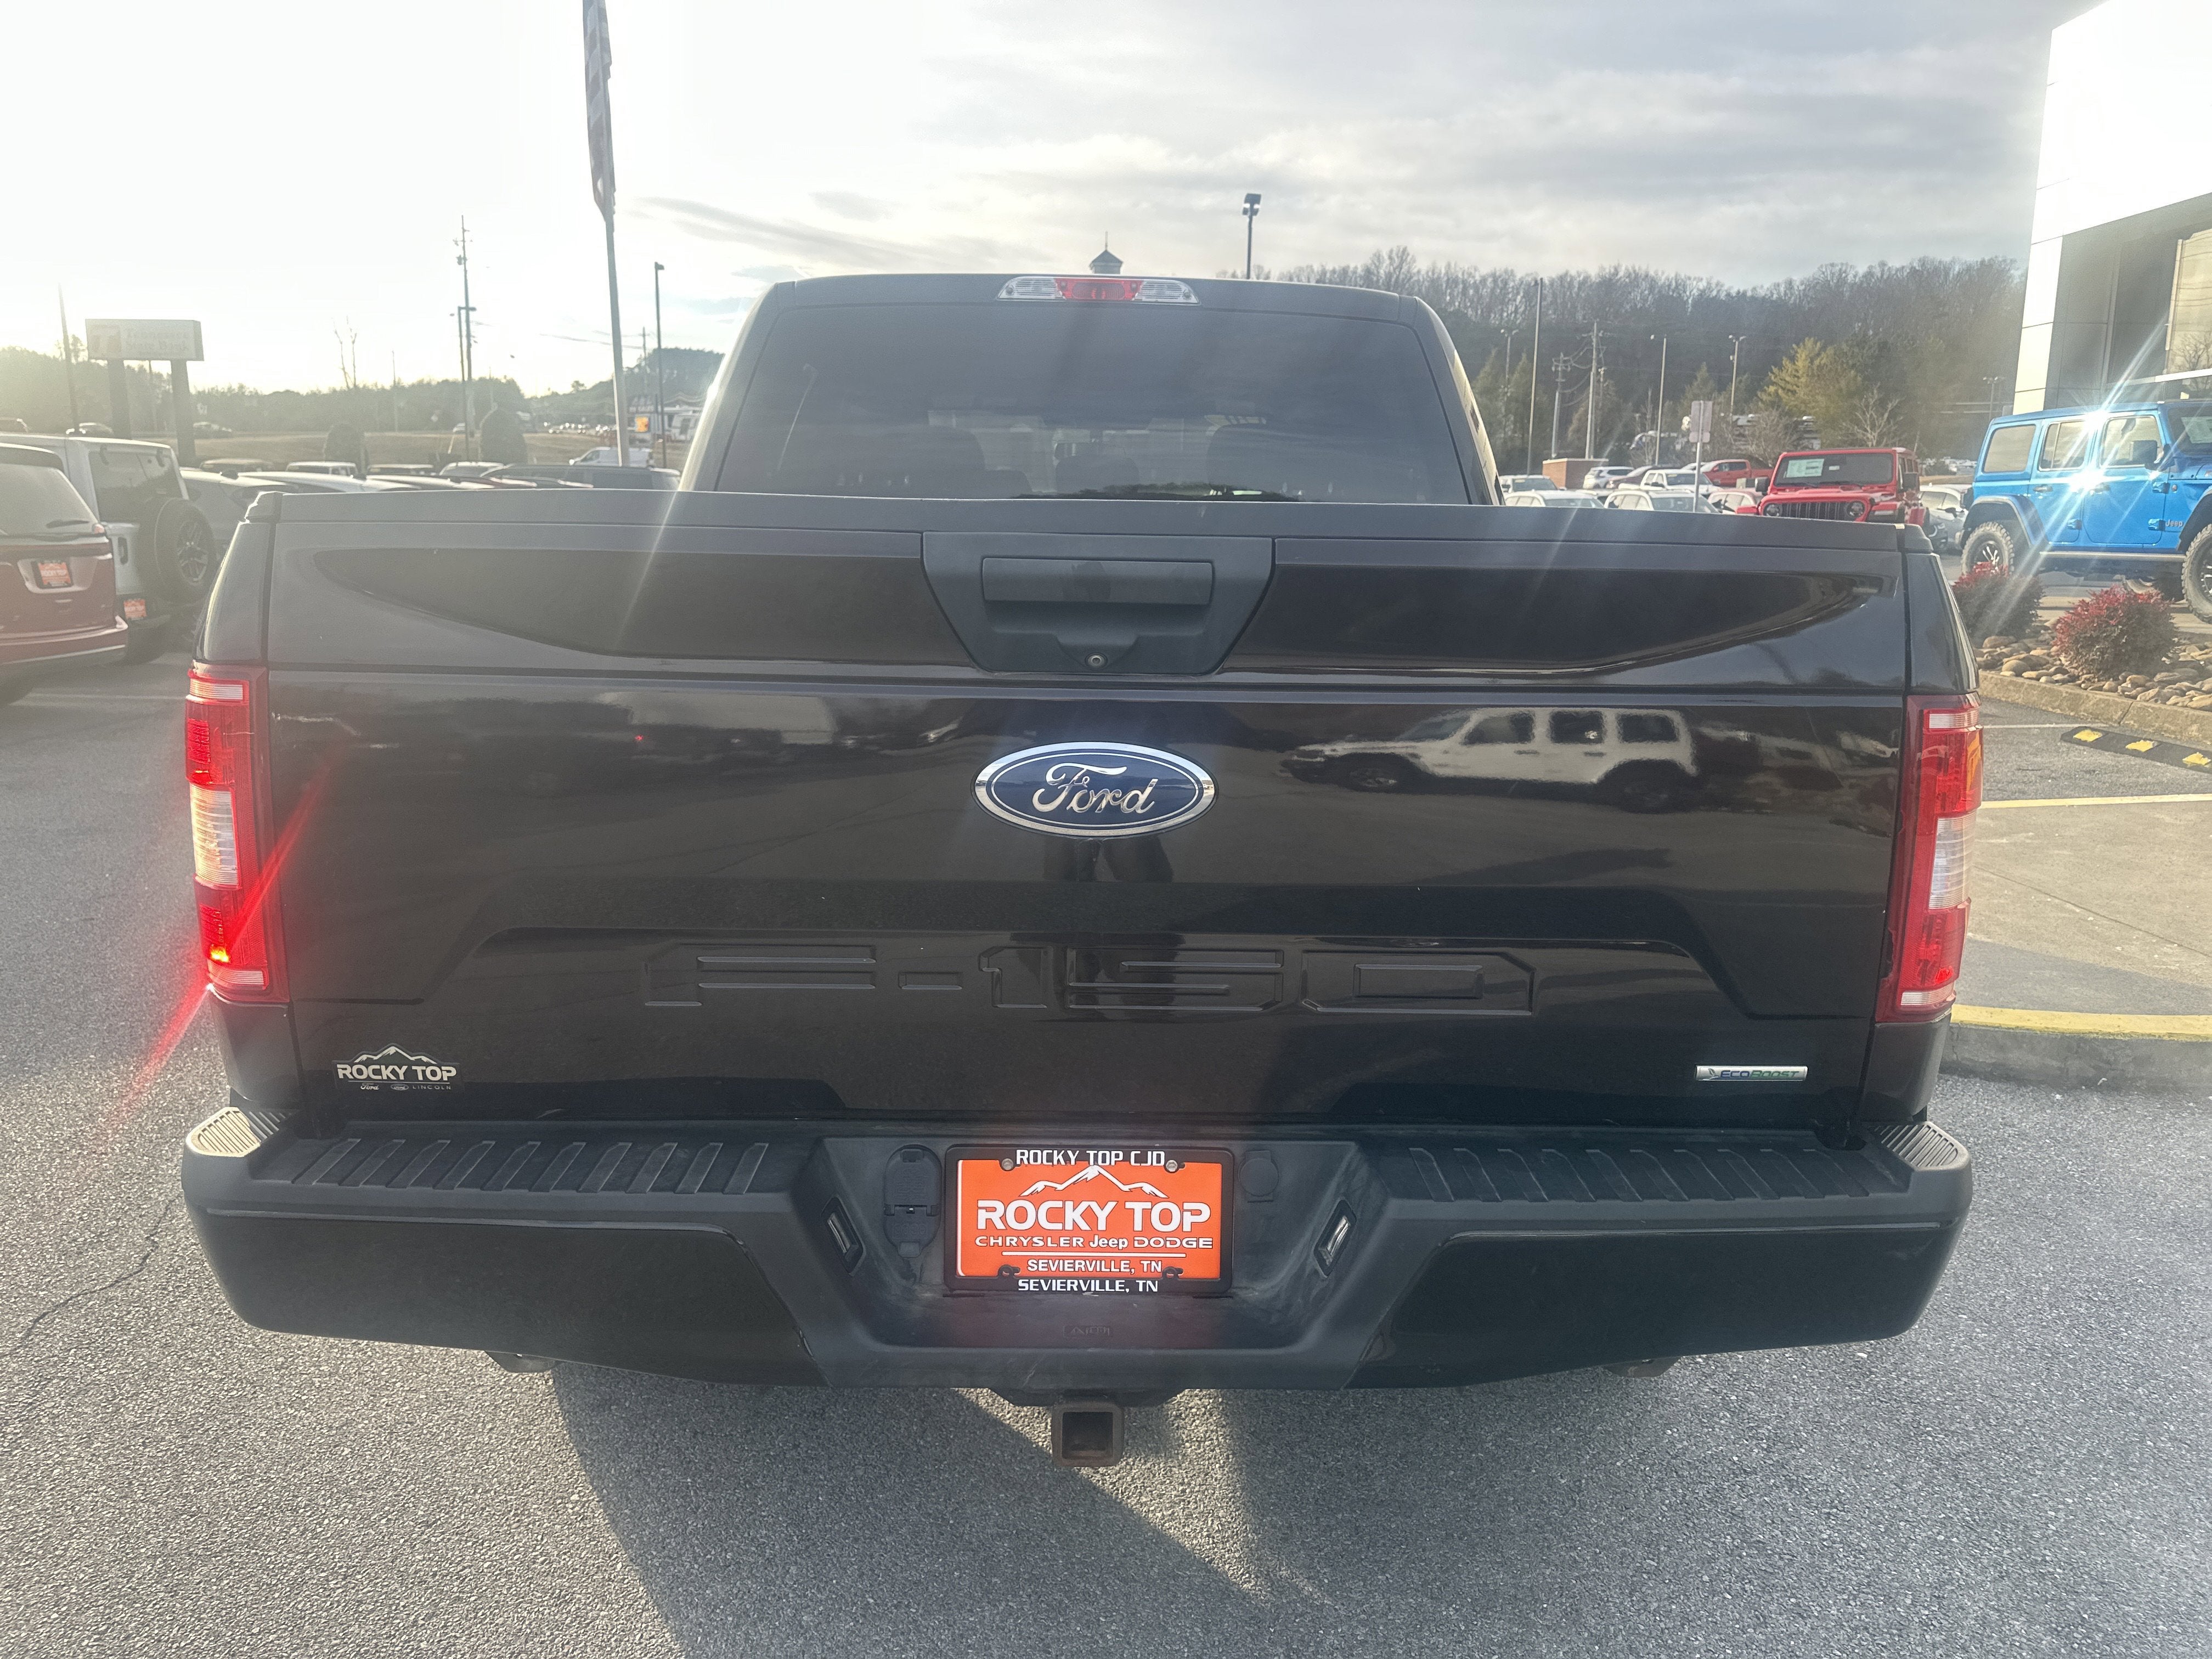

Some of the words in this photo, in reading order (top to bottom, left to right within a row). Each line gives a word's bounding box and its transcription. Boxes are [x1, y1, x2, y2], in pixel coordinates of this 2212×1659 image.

[2165, 519, 2183, 528] Jeep
[1031, 762, 1159, 814] Ford
[336, 1064, 408, 1080] ROCKY
[411, 1065, 457, 1081] TOP
[1015, 1149, 1080, 1166] ROCKY
[1086, 1150, 1124, 1166] TOP
[1130, 1150, 1165, 1166] CJD
[977, 1199, 1118, 1232] ROCKY
[1125, 1201, 1211, 1232] TOP
[975, 1235, 1085, 1248] CHRYSLER
[1088, 1234, 1128, 1250] Jeep
[1133, 1237, 1214, 1249] DODGE
[1026, 1259, 1136, 1274] SEVIERVILLE,
[1141, 1260, 1163, 1273] TN
[1018, 1279, 1130, 1294] SEVIERVILLE,
[1136, 1280, 1159, 1293] TN
